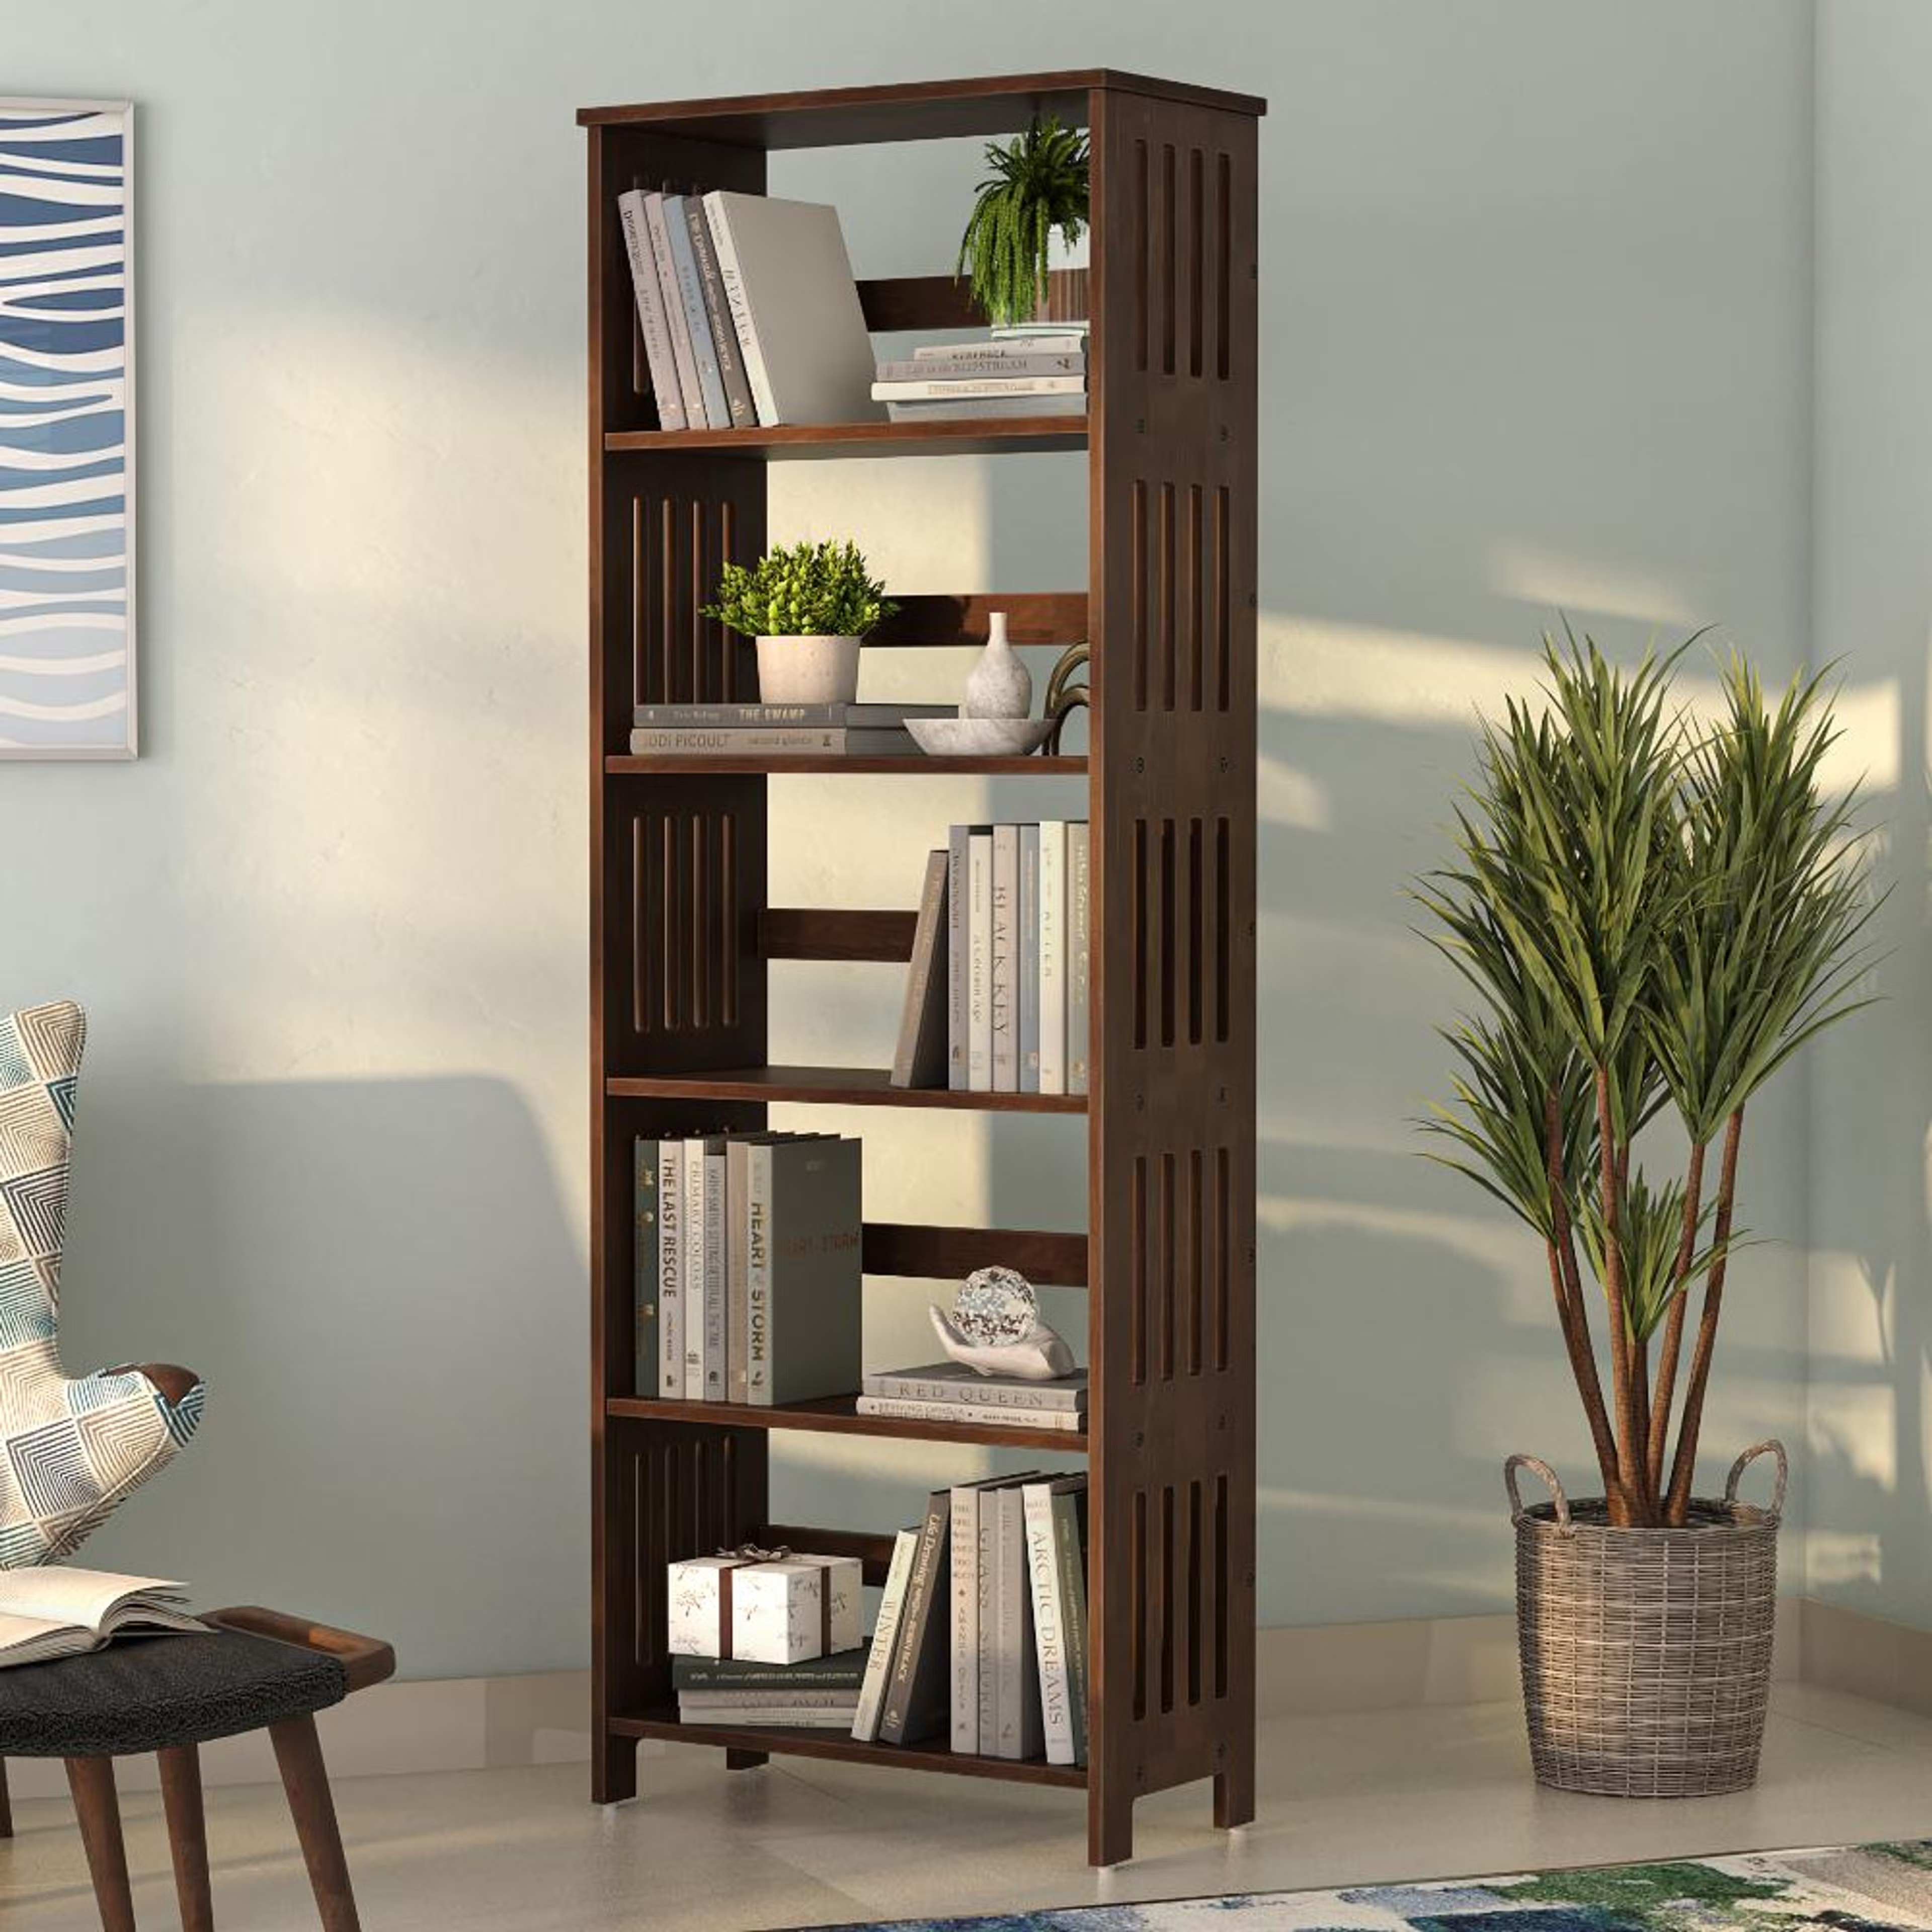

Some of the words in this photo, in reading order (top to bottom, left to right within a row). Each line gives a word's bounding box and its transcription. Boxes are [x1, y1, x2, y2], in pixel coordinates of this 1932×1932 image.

[662, 1159, 677, 1186] THE
[662, 1190, 677, 1231] LAST
[751, 1202, 765, 1268] HEART
[662, 1236, 677, 1299] RESCUE
[751, 1290, 765, 1361] STORM
[899, 1383, 944, 1398] RED
[959, 1386, 1043, 1406] QUEEN
[913, 1534, 937, 1586] Drawing
[1031, 1530, 1055, 1617] ARCTIC
[868, 1600, 897, 1671] WINTER
[1040, 1624, 1065, 1725] DREAMS
